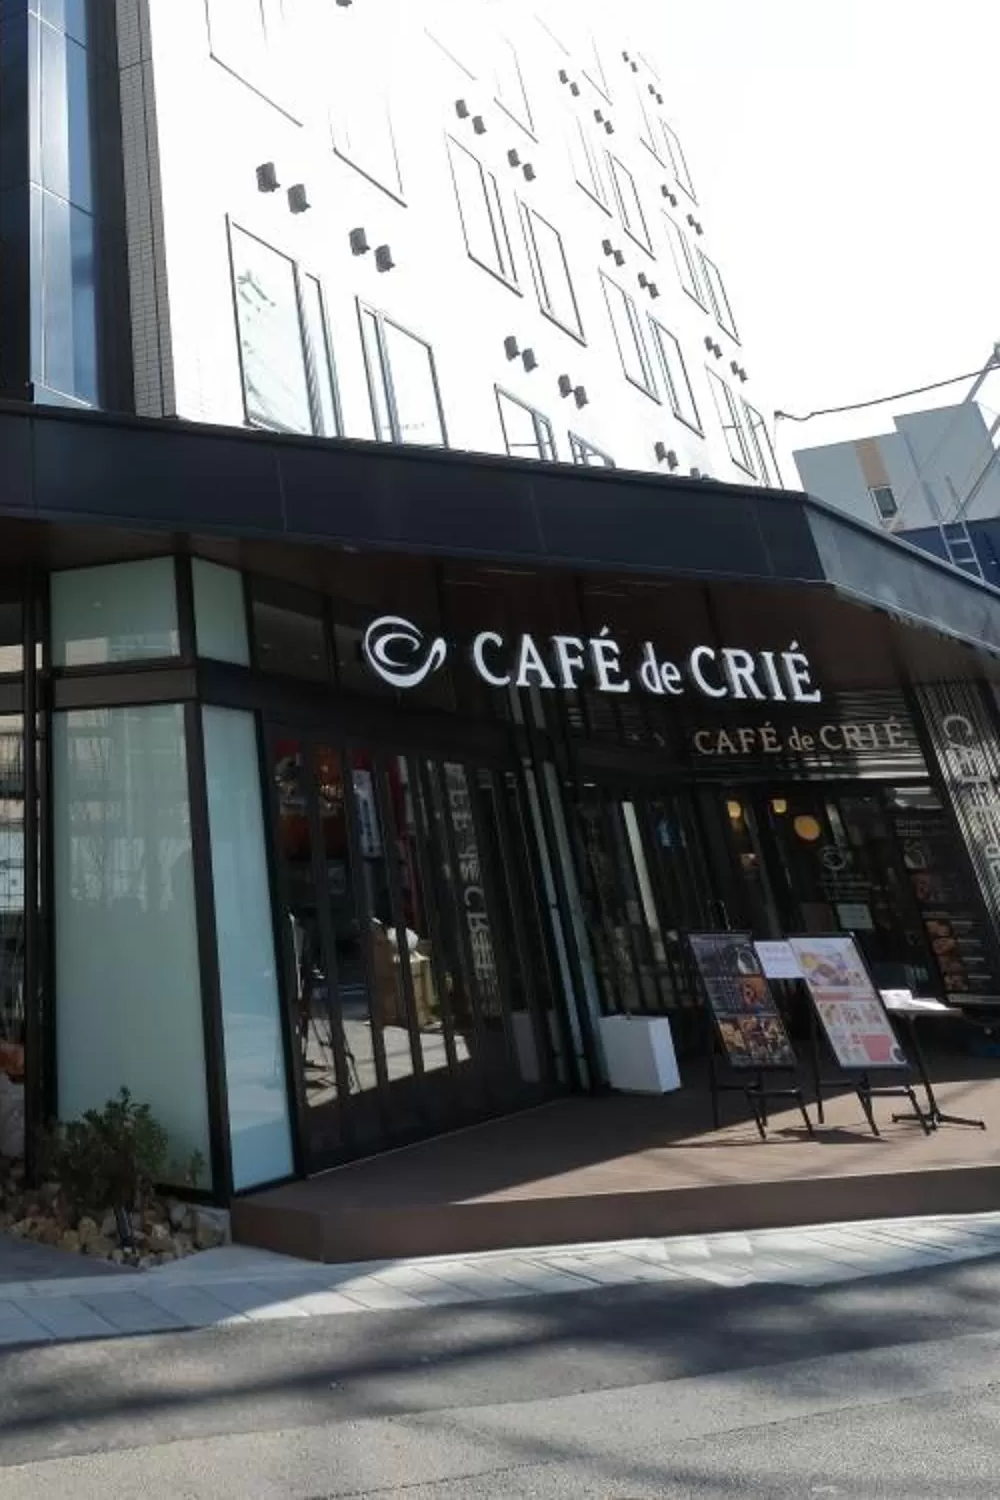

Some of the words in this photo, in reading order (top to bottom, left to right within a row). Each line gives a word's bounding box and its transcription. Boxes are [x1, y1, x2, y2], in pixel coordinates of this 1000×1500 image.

[472, 626, 631, 694] CAFÉ
[641, 641, 685, 696] de
[689, 639, 822, 702] CRIÉ
[693, 720, 783, 755] CAFÉ
[788, 726, 815, 752] de
[819, 716, 909, 751] CRIÉ
